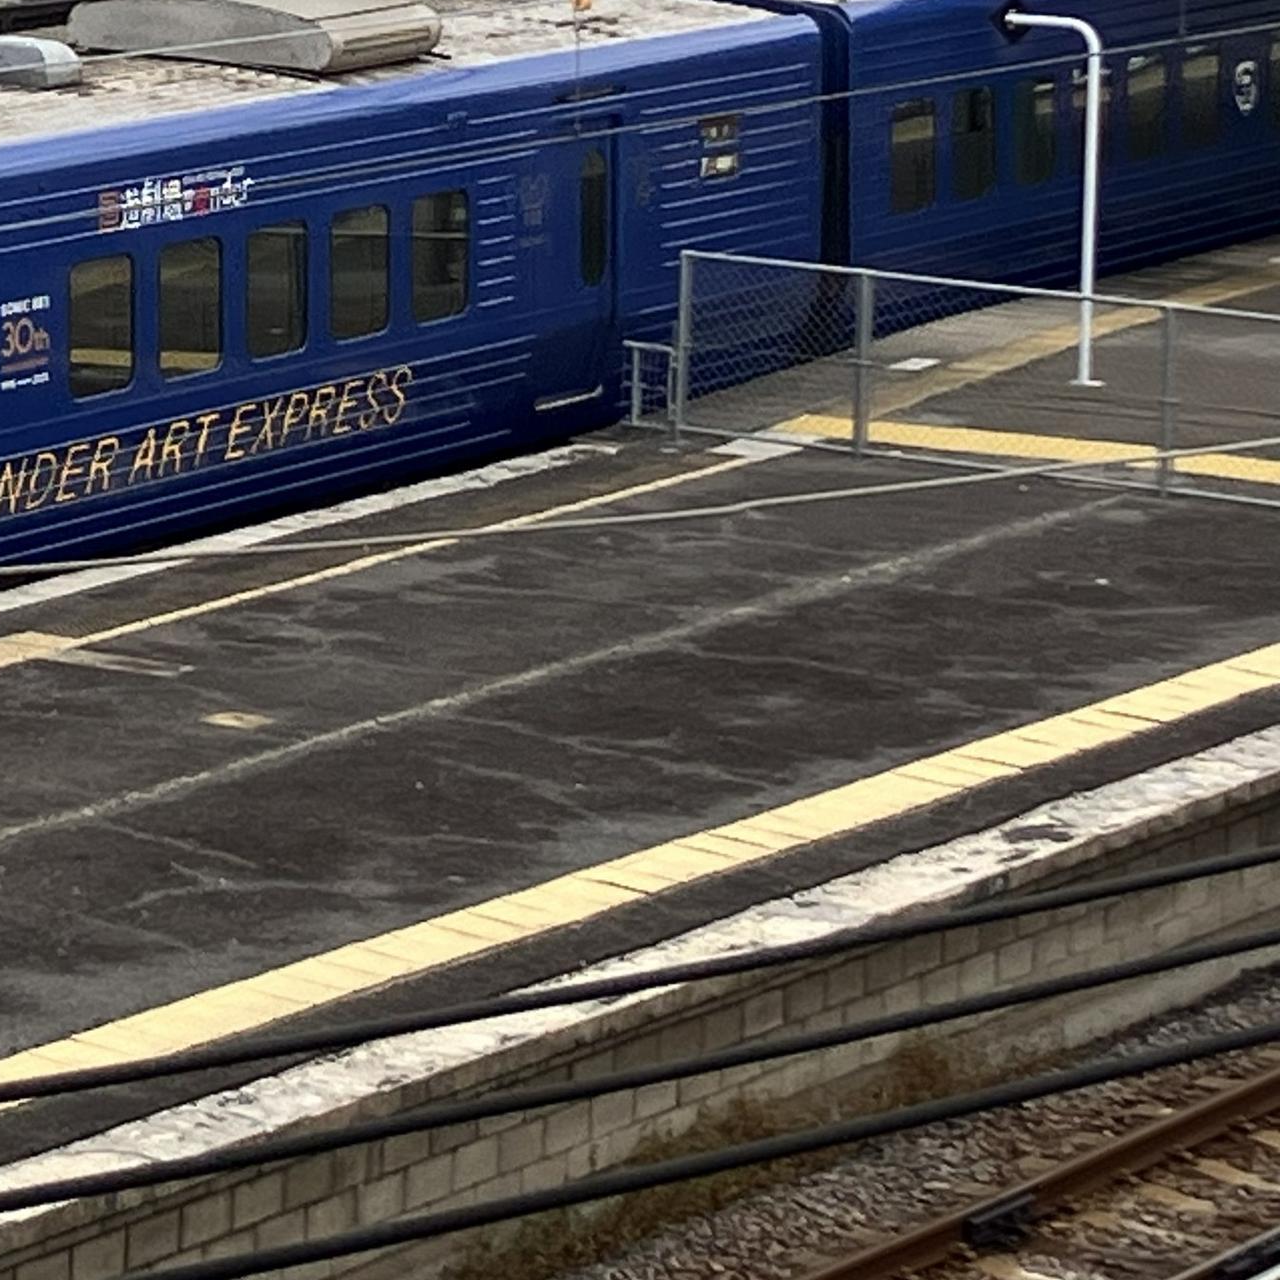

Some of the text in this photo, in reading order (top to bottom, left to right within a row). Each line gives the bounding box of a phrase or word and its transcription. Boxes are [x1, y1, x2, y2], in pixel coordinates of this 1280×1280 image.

[0, 317, 51, 358] 30th
[129, 411, 221, 486] ART
[223, 364, 414, 461] EXPRESS
